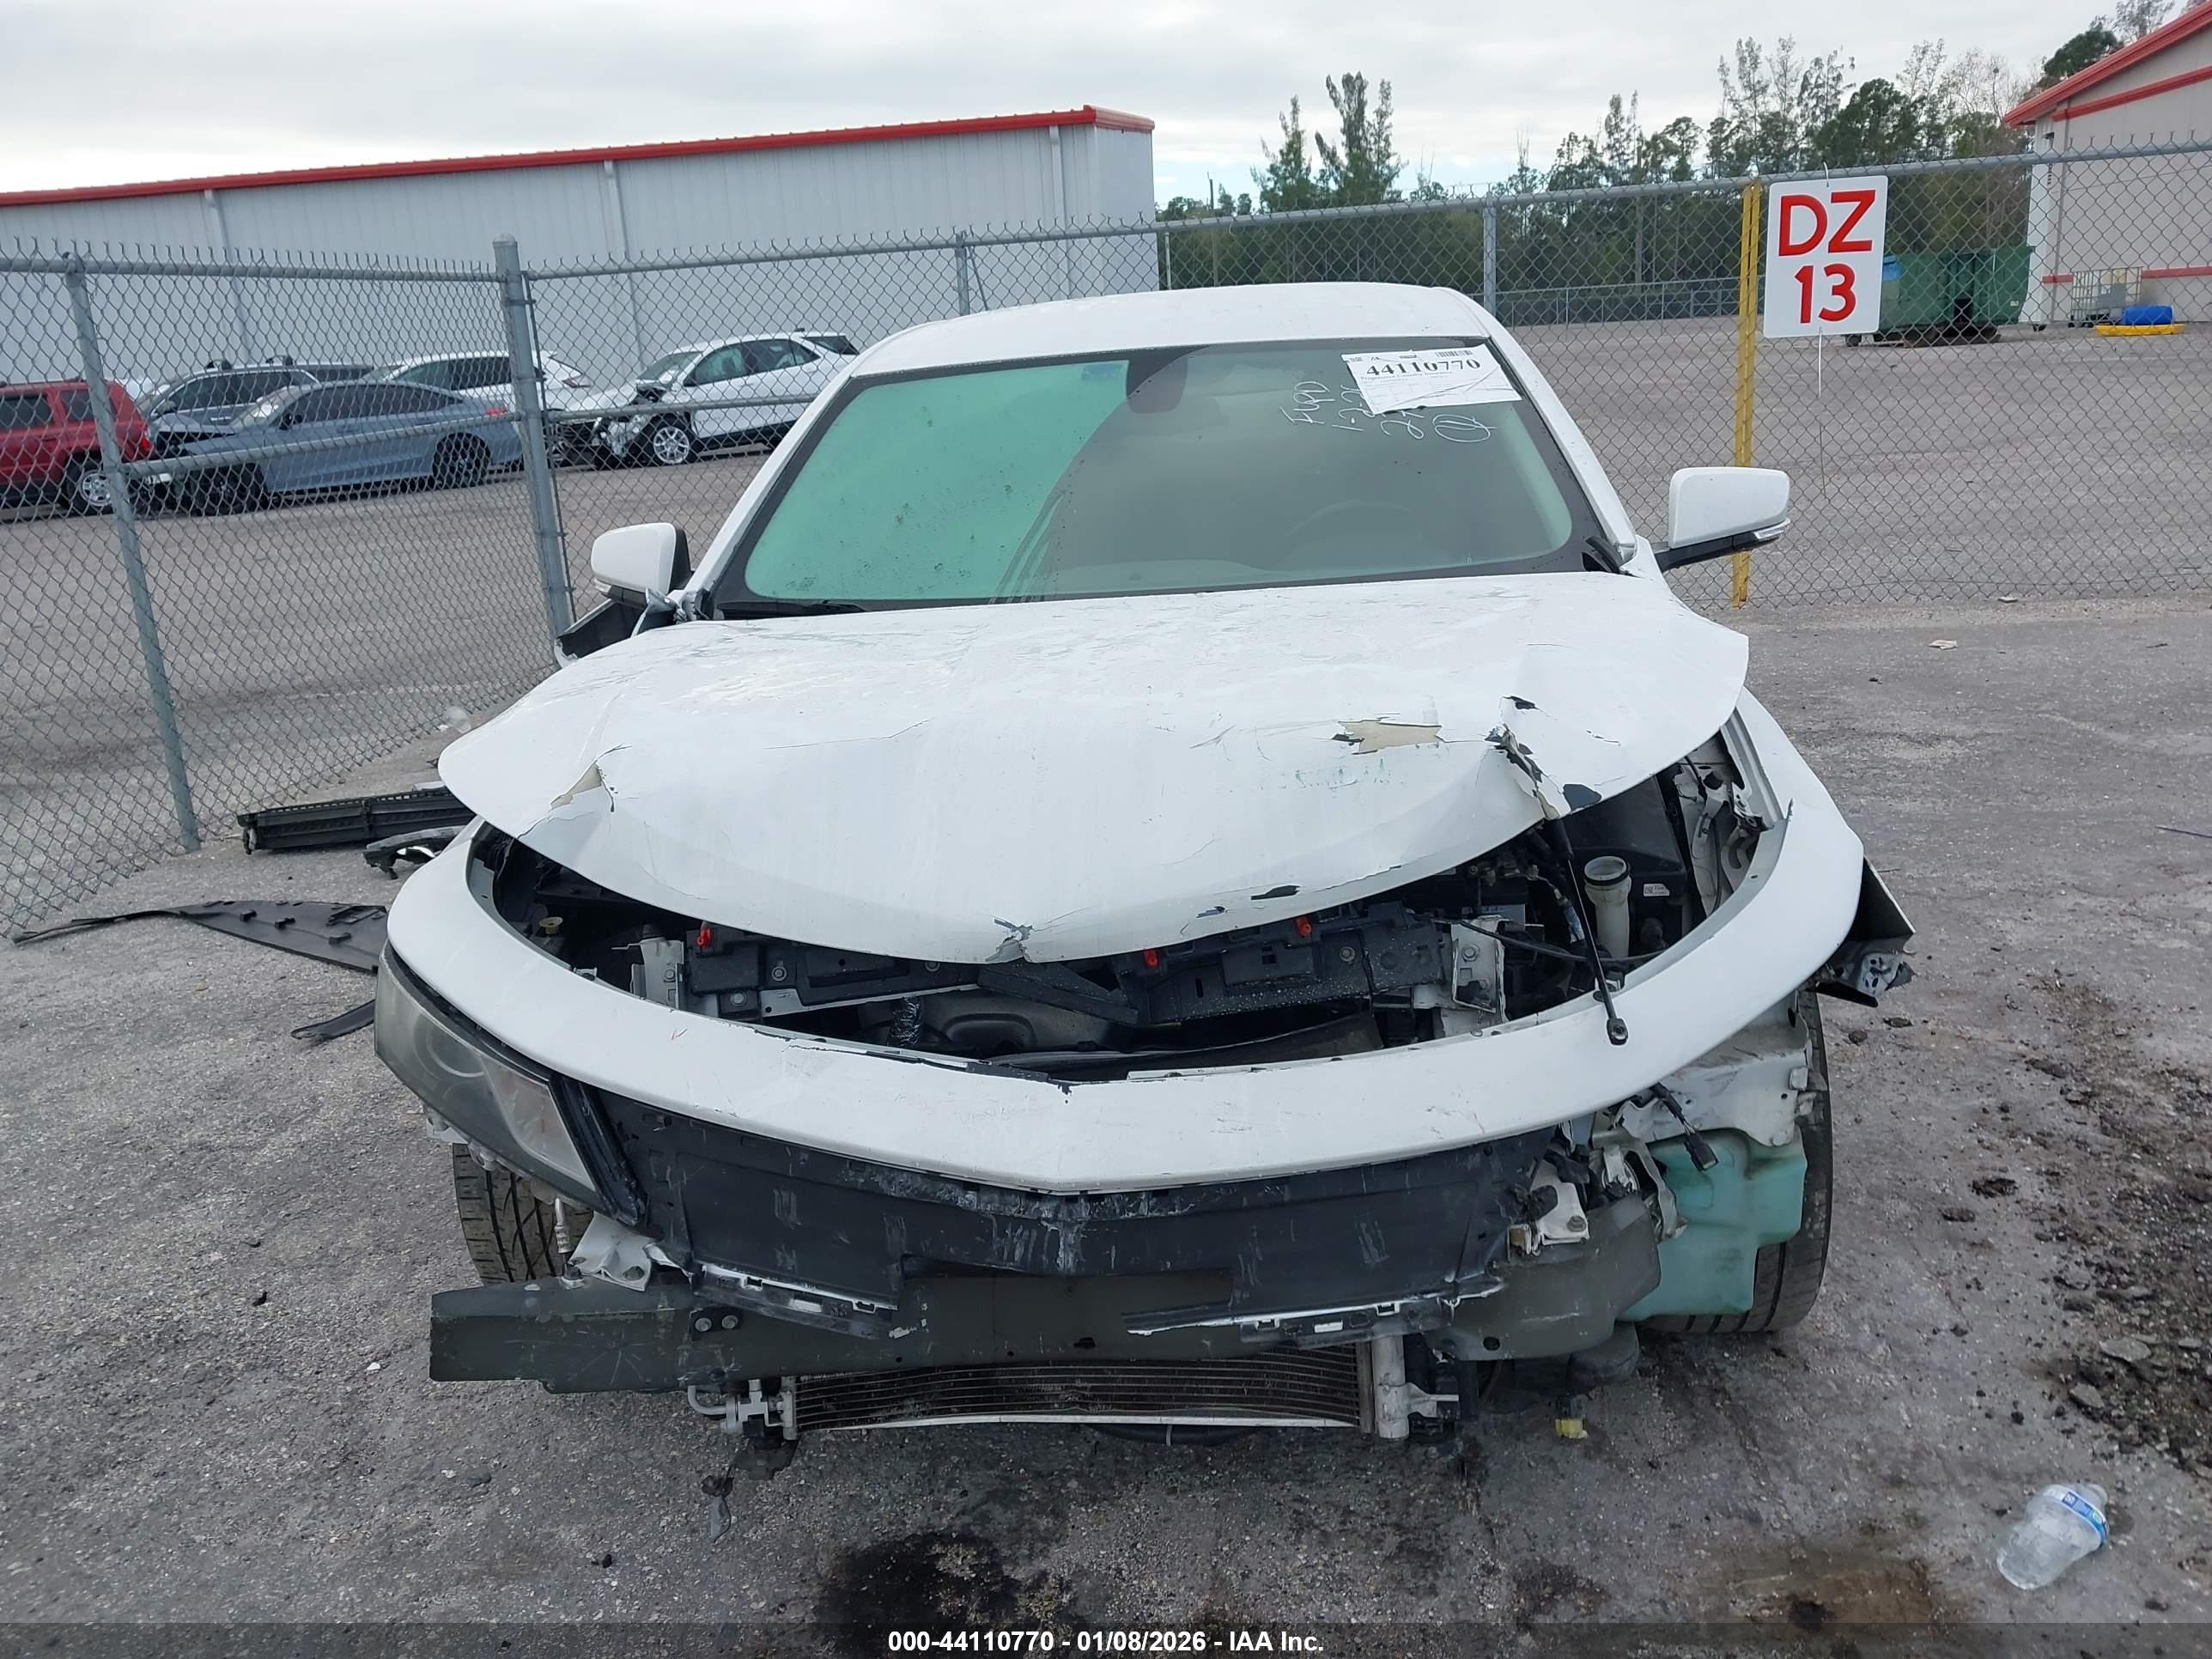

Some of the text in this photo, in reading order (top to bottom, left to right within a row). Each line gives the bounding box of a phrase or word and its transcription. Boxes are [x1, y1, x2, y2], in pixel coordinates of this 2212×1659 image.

[1778, 189, 1876, 257] DZ
[1794, 263, 1856, 324] 13
[1366, 358, 1480, 375] 44110770
